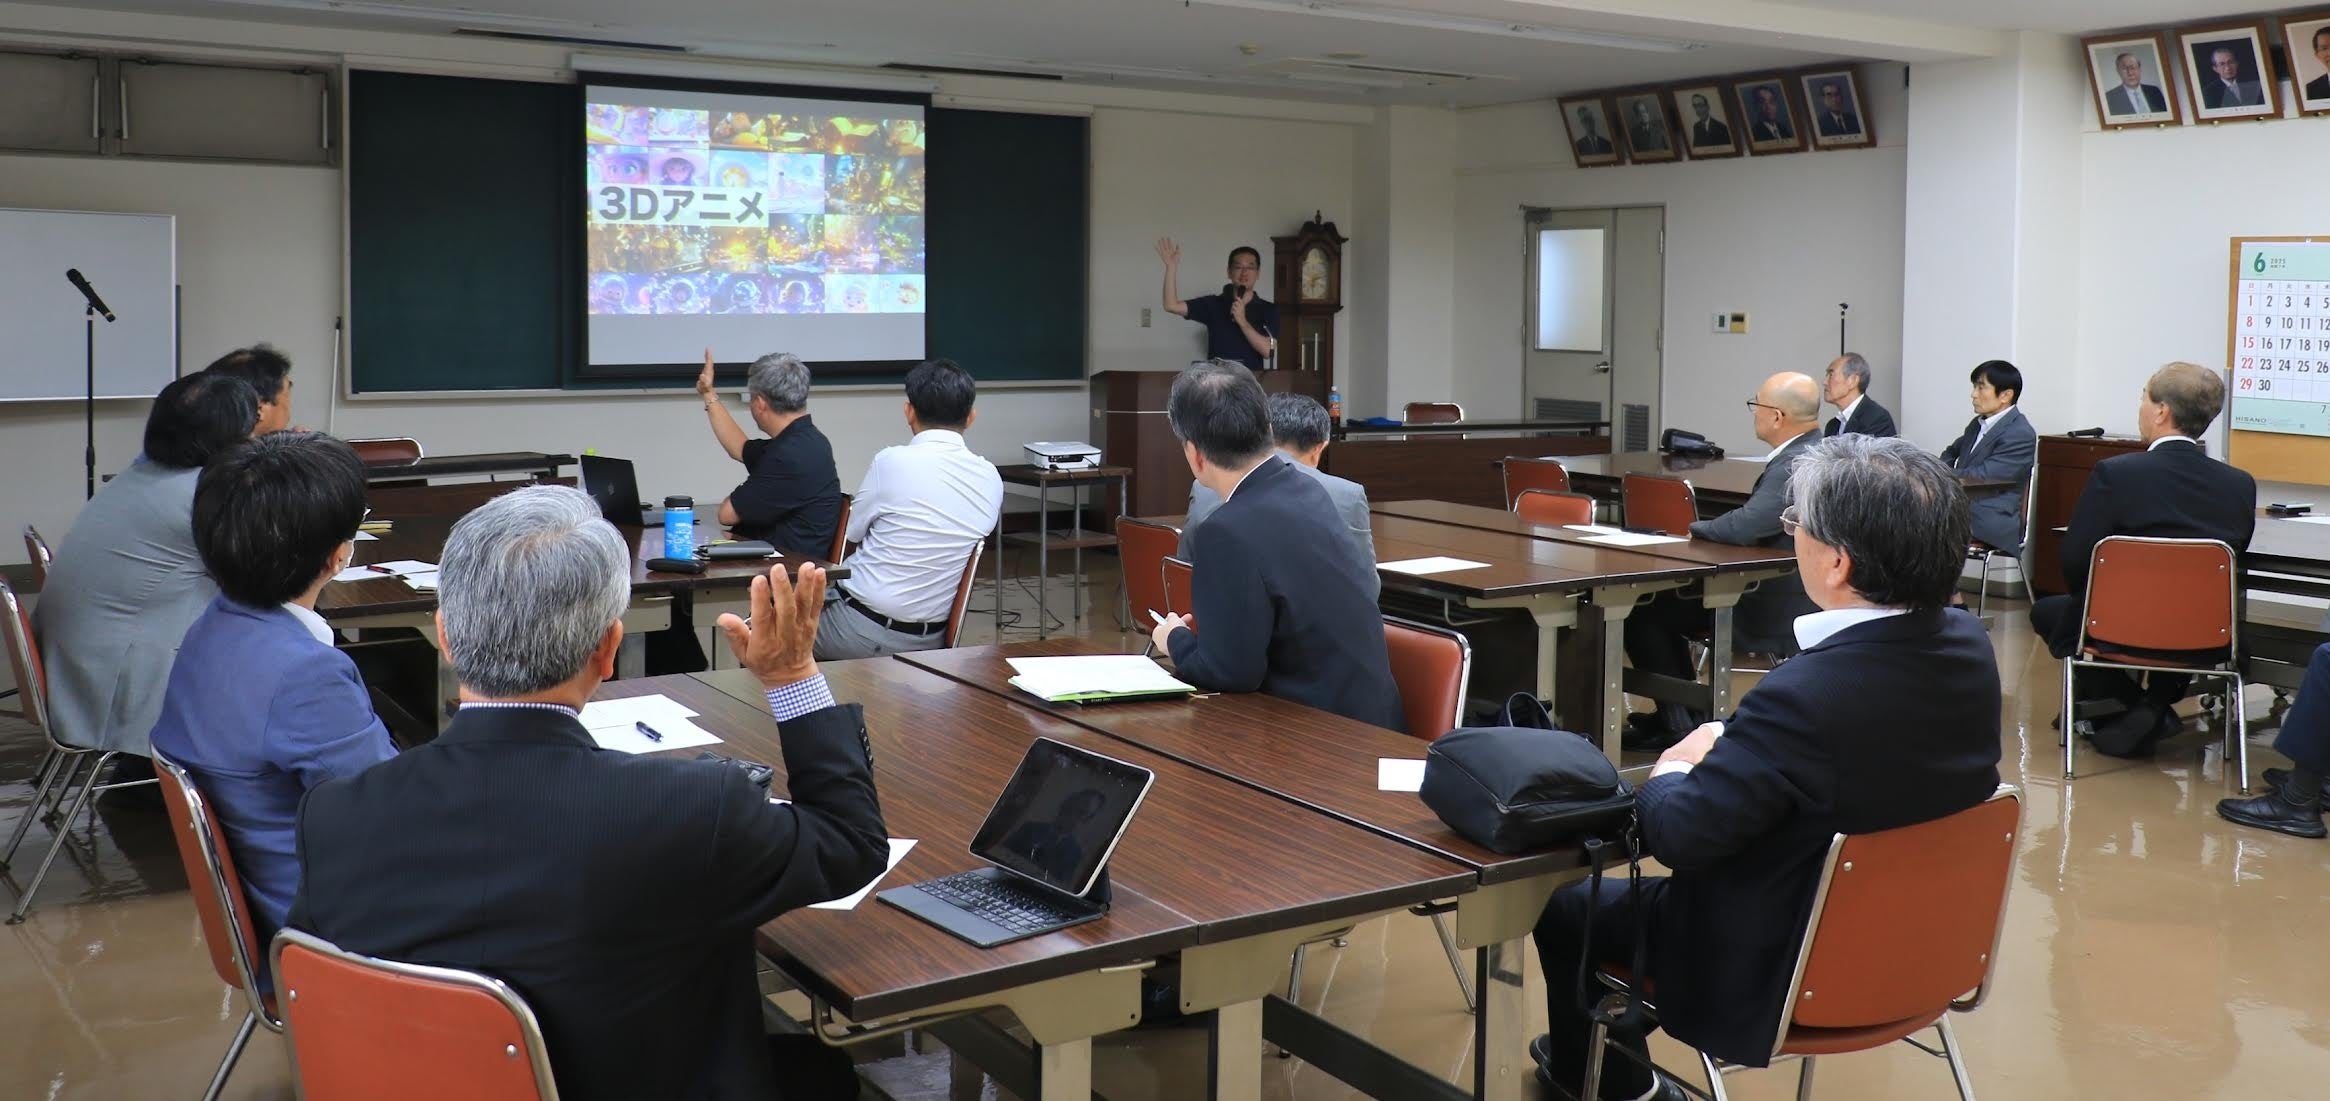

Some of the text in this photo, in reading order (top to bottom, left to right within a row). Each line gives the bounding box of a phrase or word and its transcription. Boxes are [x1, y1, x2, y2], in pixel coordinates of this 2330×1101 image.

[600, 186, 764, 223] 3Dアニメ
[2254, 252, 2266, 273] 6
[2249, 295, 2330, 309] 1 2 3 4 5
[2246, 316, 2330, 330] 8 9 10 11 12
[2243, 336, 2330, 352] 15 16 17 18 19
[2241, 357, 2329, 373] 22 23 24 25 26
[2240, 378, 2271, 391] 29 30
[2321, 404, 2327, 414] 7
